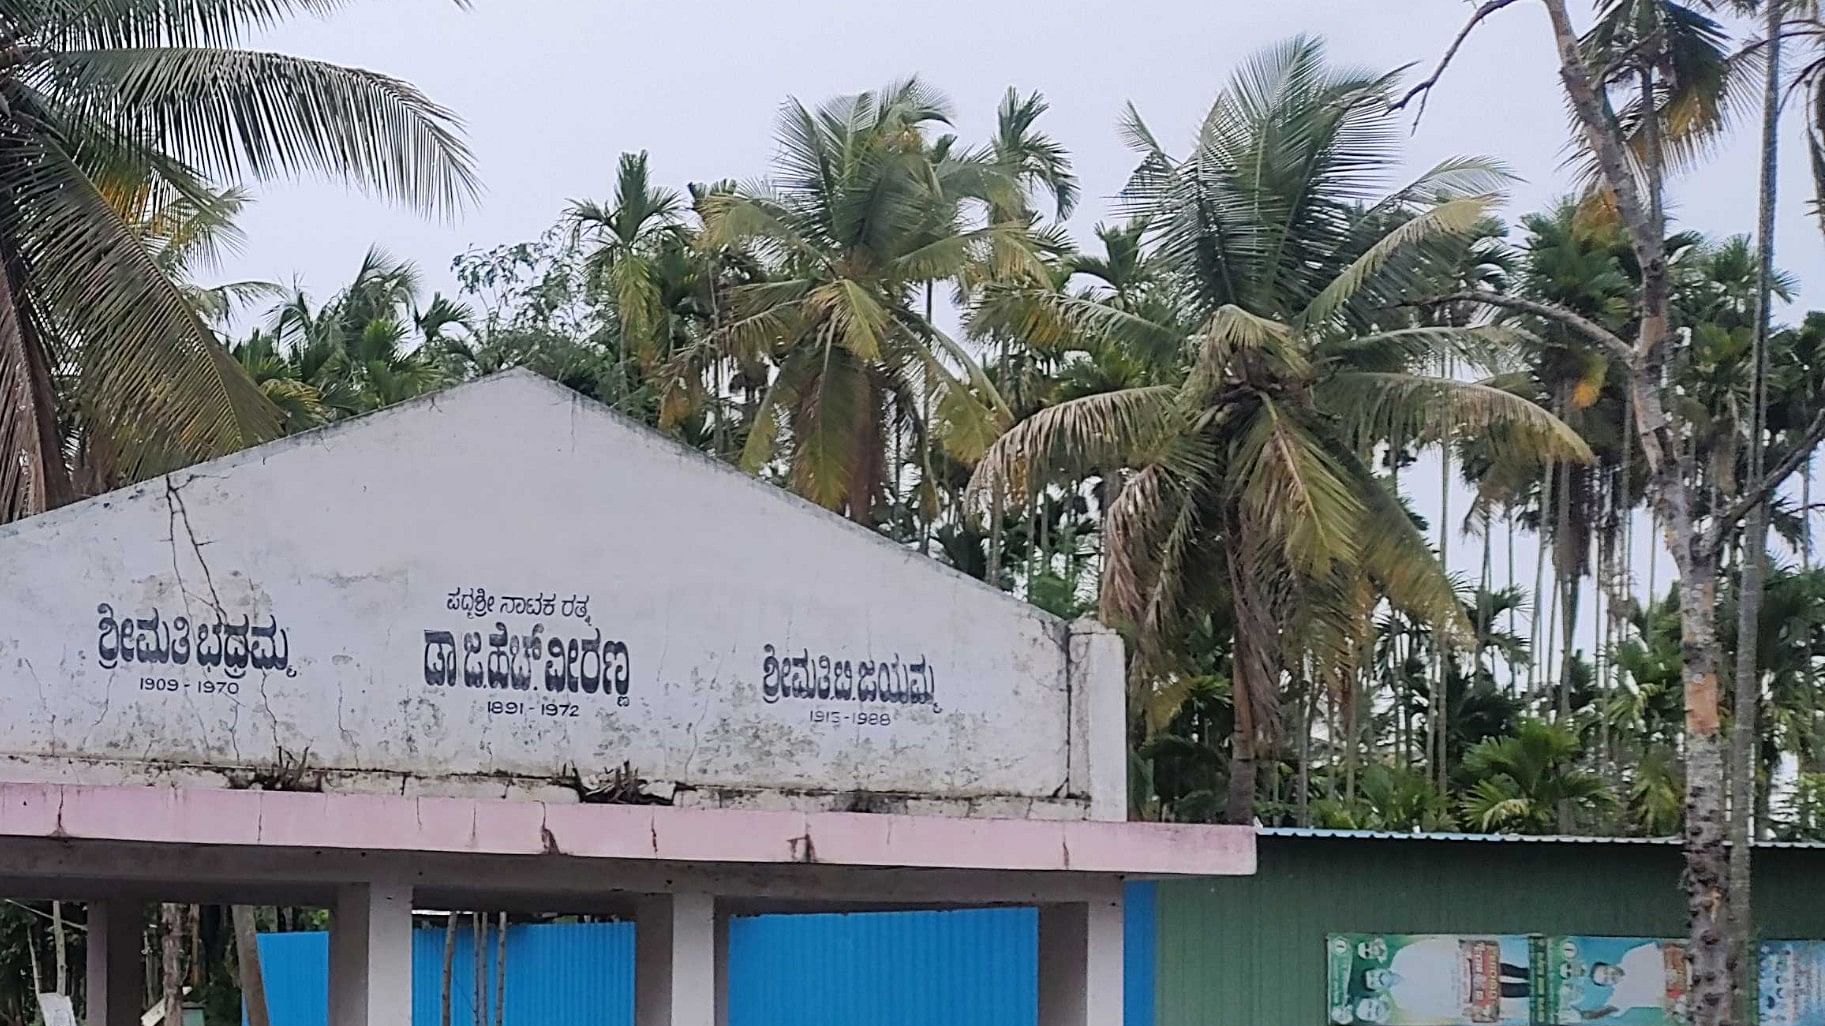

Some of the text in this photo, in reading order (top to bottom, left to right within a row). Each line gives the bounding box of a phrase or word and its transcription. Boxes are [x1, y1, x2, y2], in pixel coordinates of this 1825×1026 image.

[499, 592, 557, 616] ನಾಟಕ
[561, 594, 592, 627] ರತ್ನ
[97, 602, 191, 669] ಶ್ರೀಮತಿ
